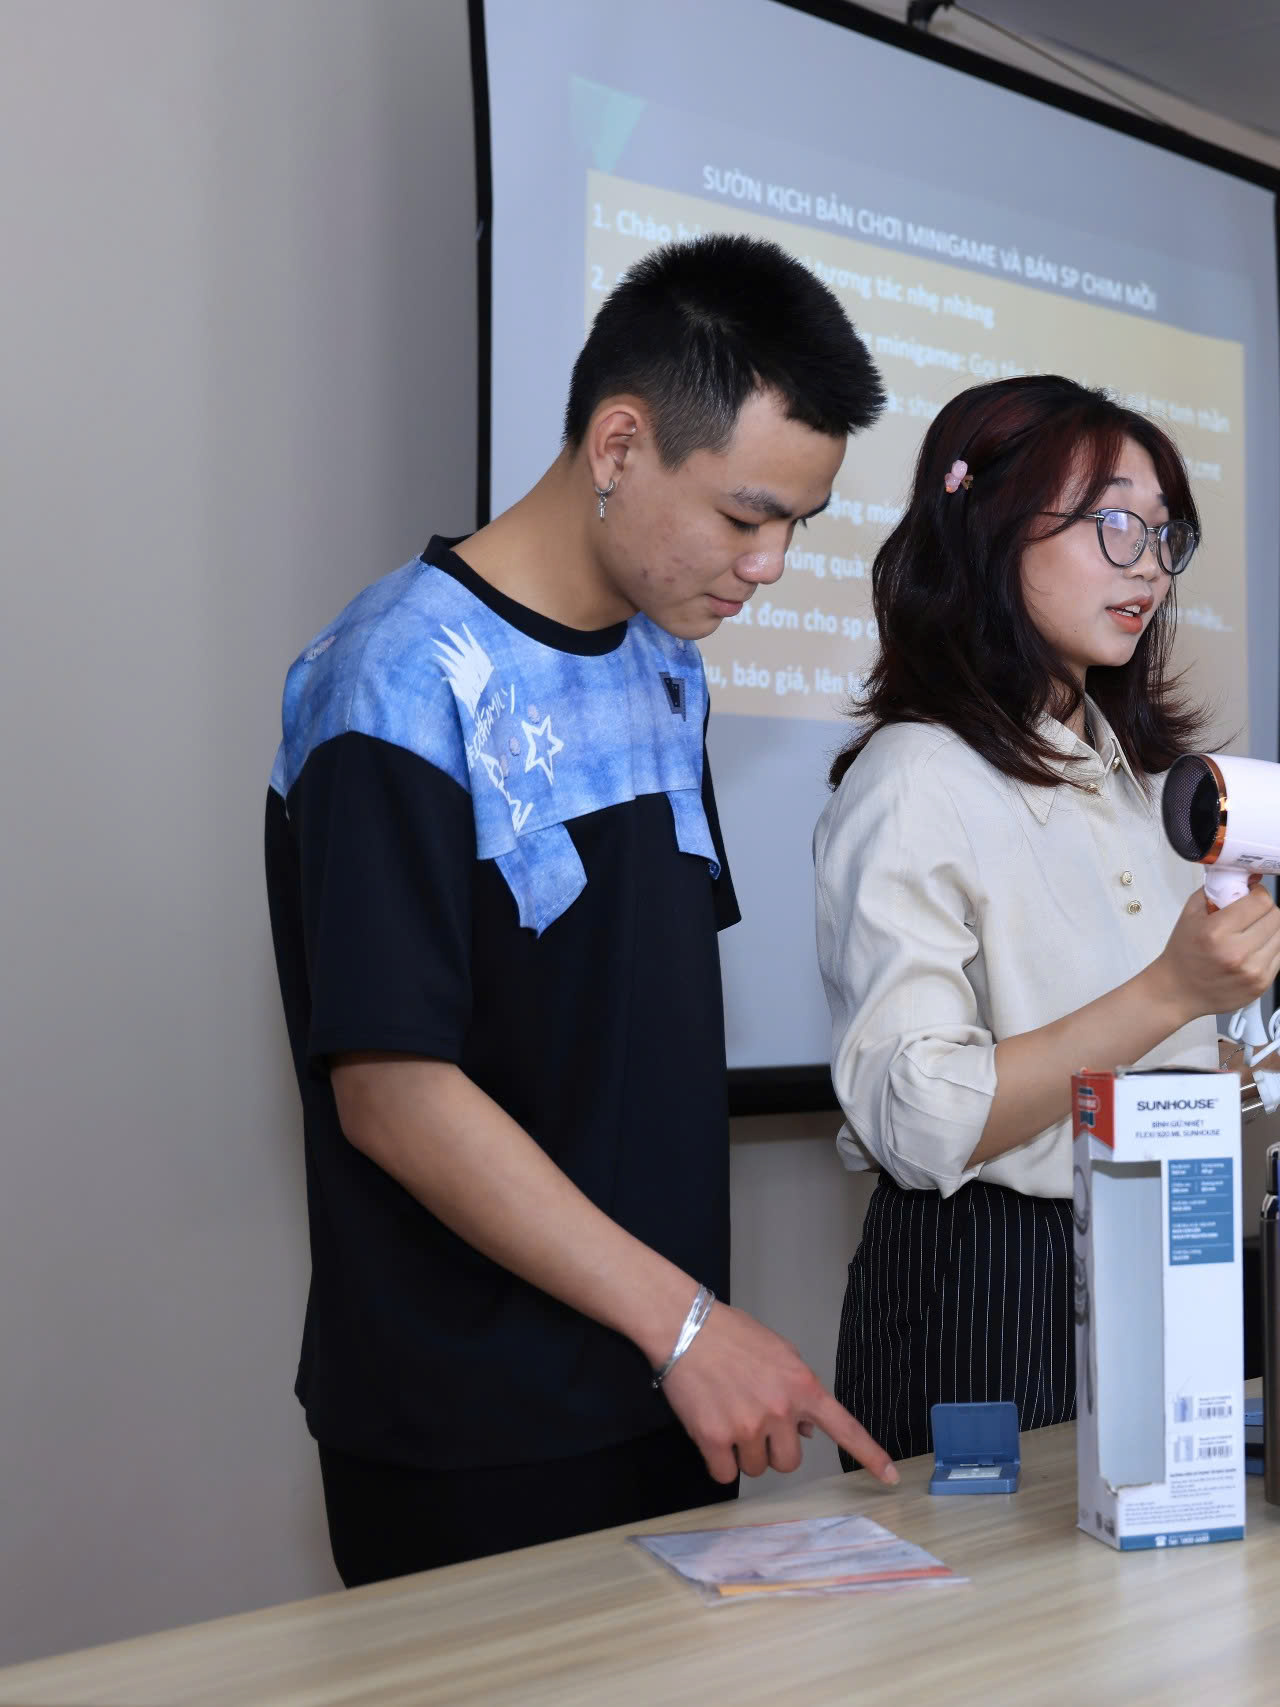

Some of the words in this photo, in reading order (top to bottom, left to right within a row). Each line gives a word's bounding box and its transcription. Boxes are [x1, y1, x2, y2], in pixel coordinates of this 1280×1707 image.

[592, 202, 611, 230] 1.
[615, 209, 672, 242] Chào
[766, 183, 811, 217] KỊCH
[906, 222, 998, 268] MINIGAME
[1000, 247, 1022, 276] VÀ
[1060, 265, 1080, 289] SP
[757, 602, 798, 629] đơn
[803, 604, 838, 633] cho
[841, 618, 863, 640] sp
[732, 660, 770, 687] báo
[1136, 1098, 1216, 1112] SUNHOUSE
